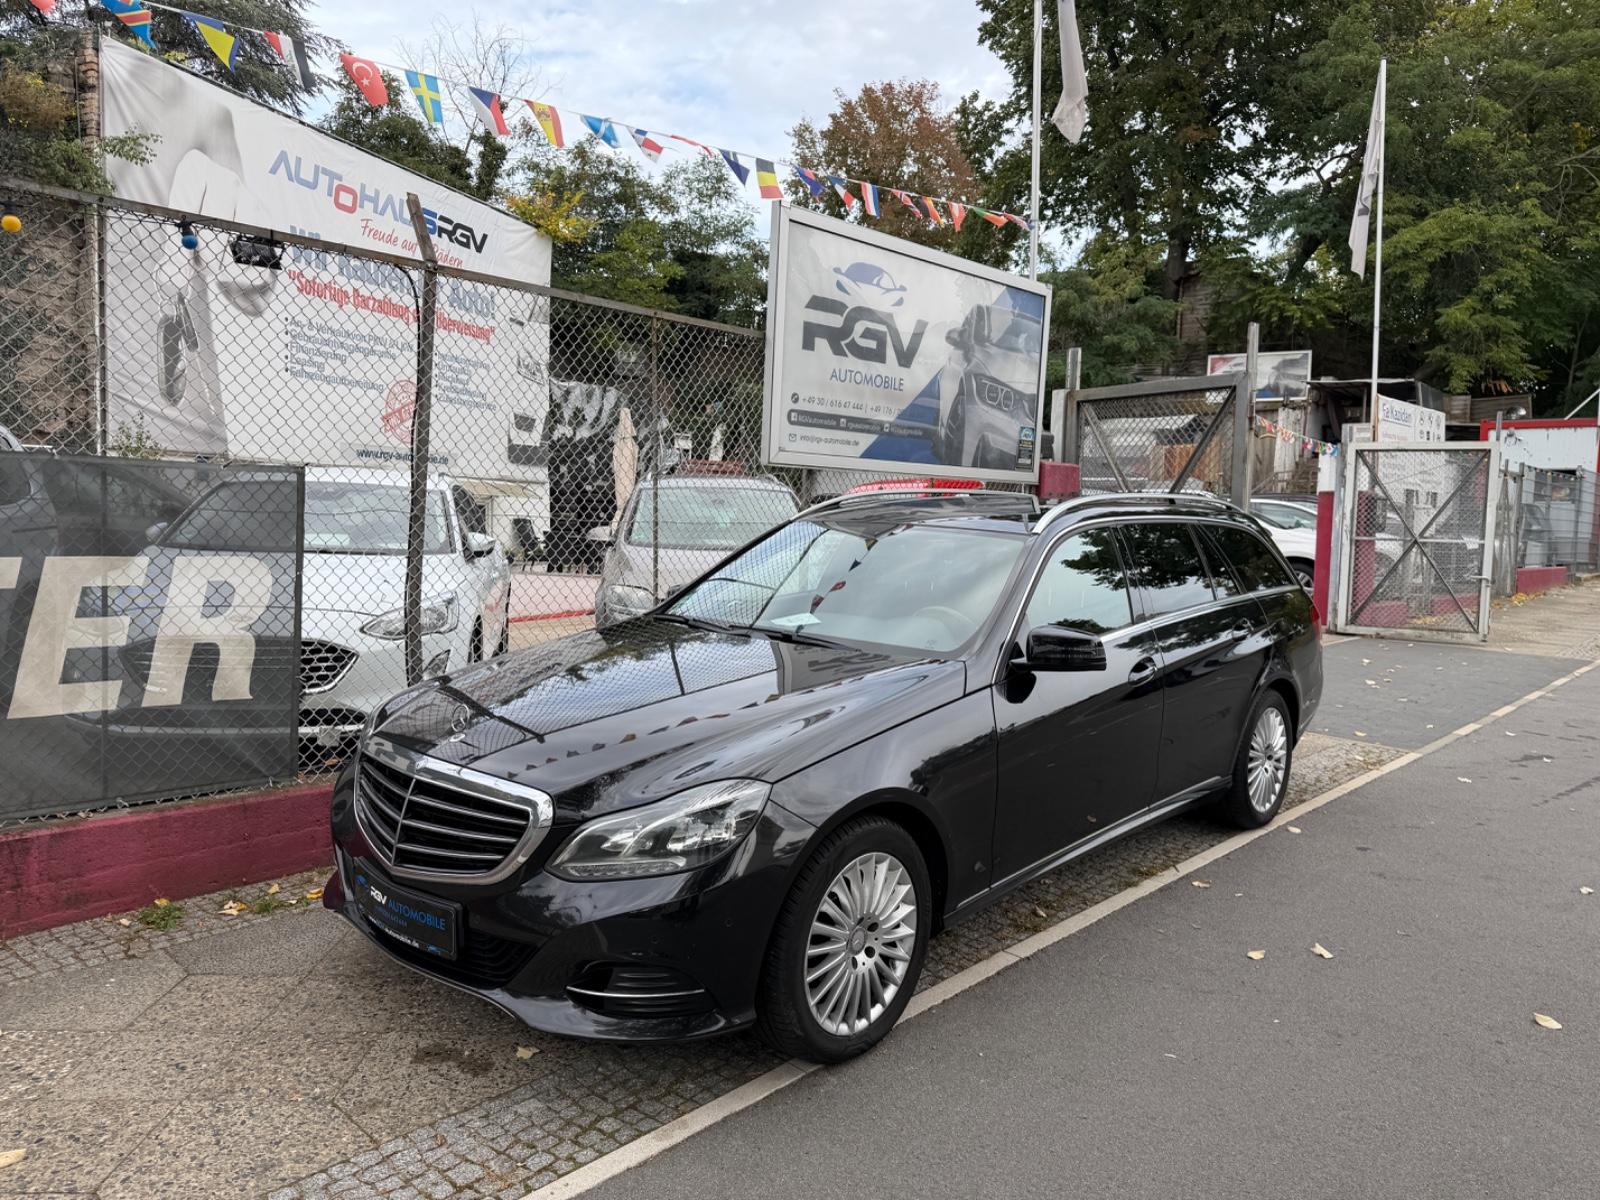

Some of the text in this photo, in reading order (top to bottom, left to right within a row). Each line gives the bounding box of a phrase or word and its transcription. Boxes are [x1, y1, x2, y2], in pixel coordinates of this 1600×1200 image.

[360, 218, 398, 246] Freude
[802, 294, 929, 369] RGV
[289, 342, 347, 364] Finanzierung
[289, 354, 325, 373] Leasing
[830, 369, 904, 392] AUTOMOBILE
[0, 556, 272, 719] ER
[370, 885, 388, 905] RGV
[388, 899, 446, 931] AUTOMOBILE
